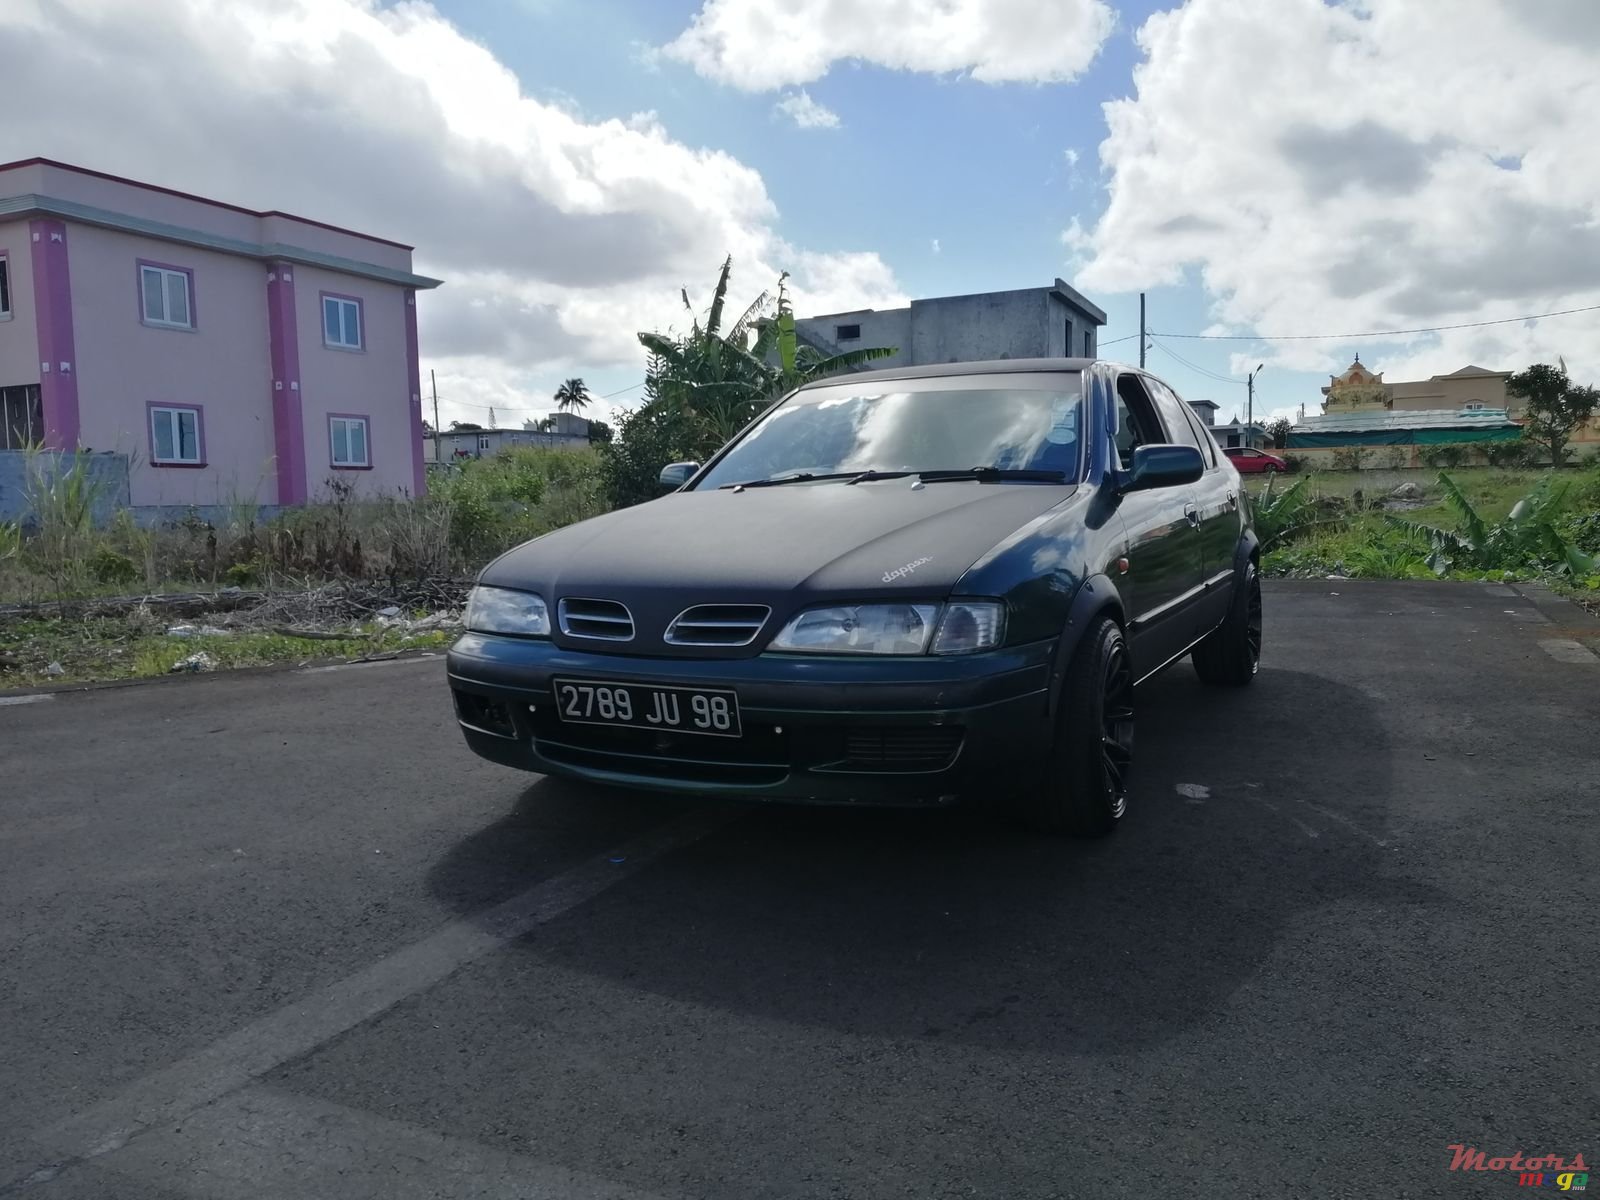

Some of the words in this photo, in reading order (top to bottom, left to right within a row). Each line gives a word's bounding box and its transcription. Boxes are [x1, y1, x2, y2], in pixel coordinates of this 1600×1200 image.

[562, 685, 633, 720] 2789
[646, 692, 681, 725] JU
[691, 695, 731, 730] 98
